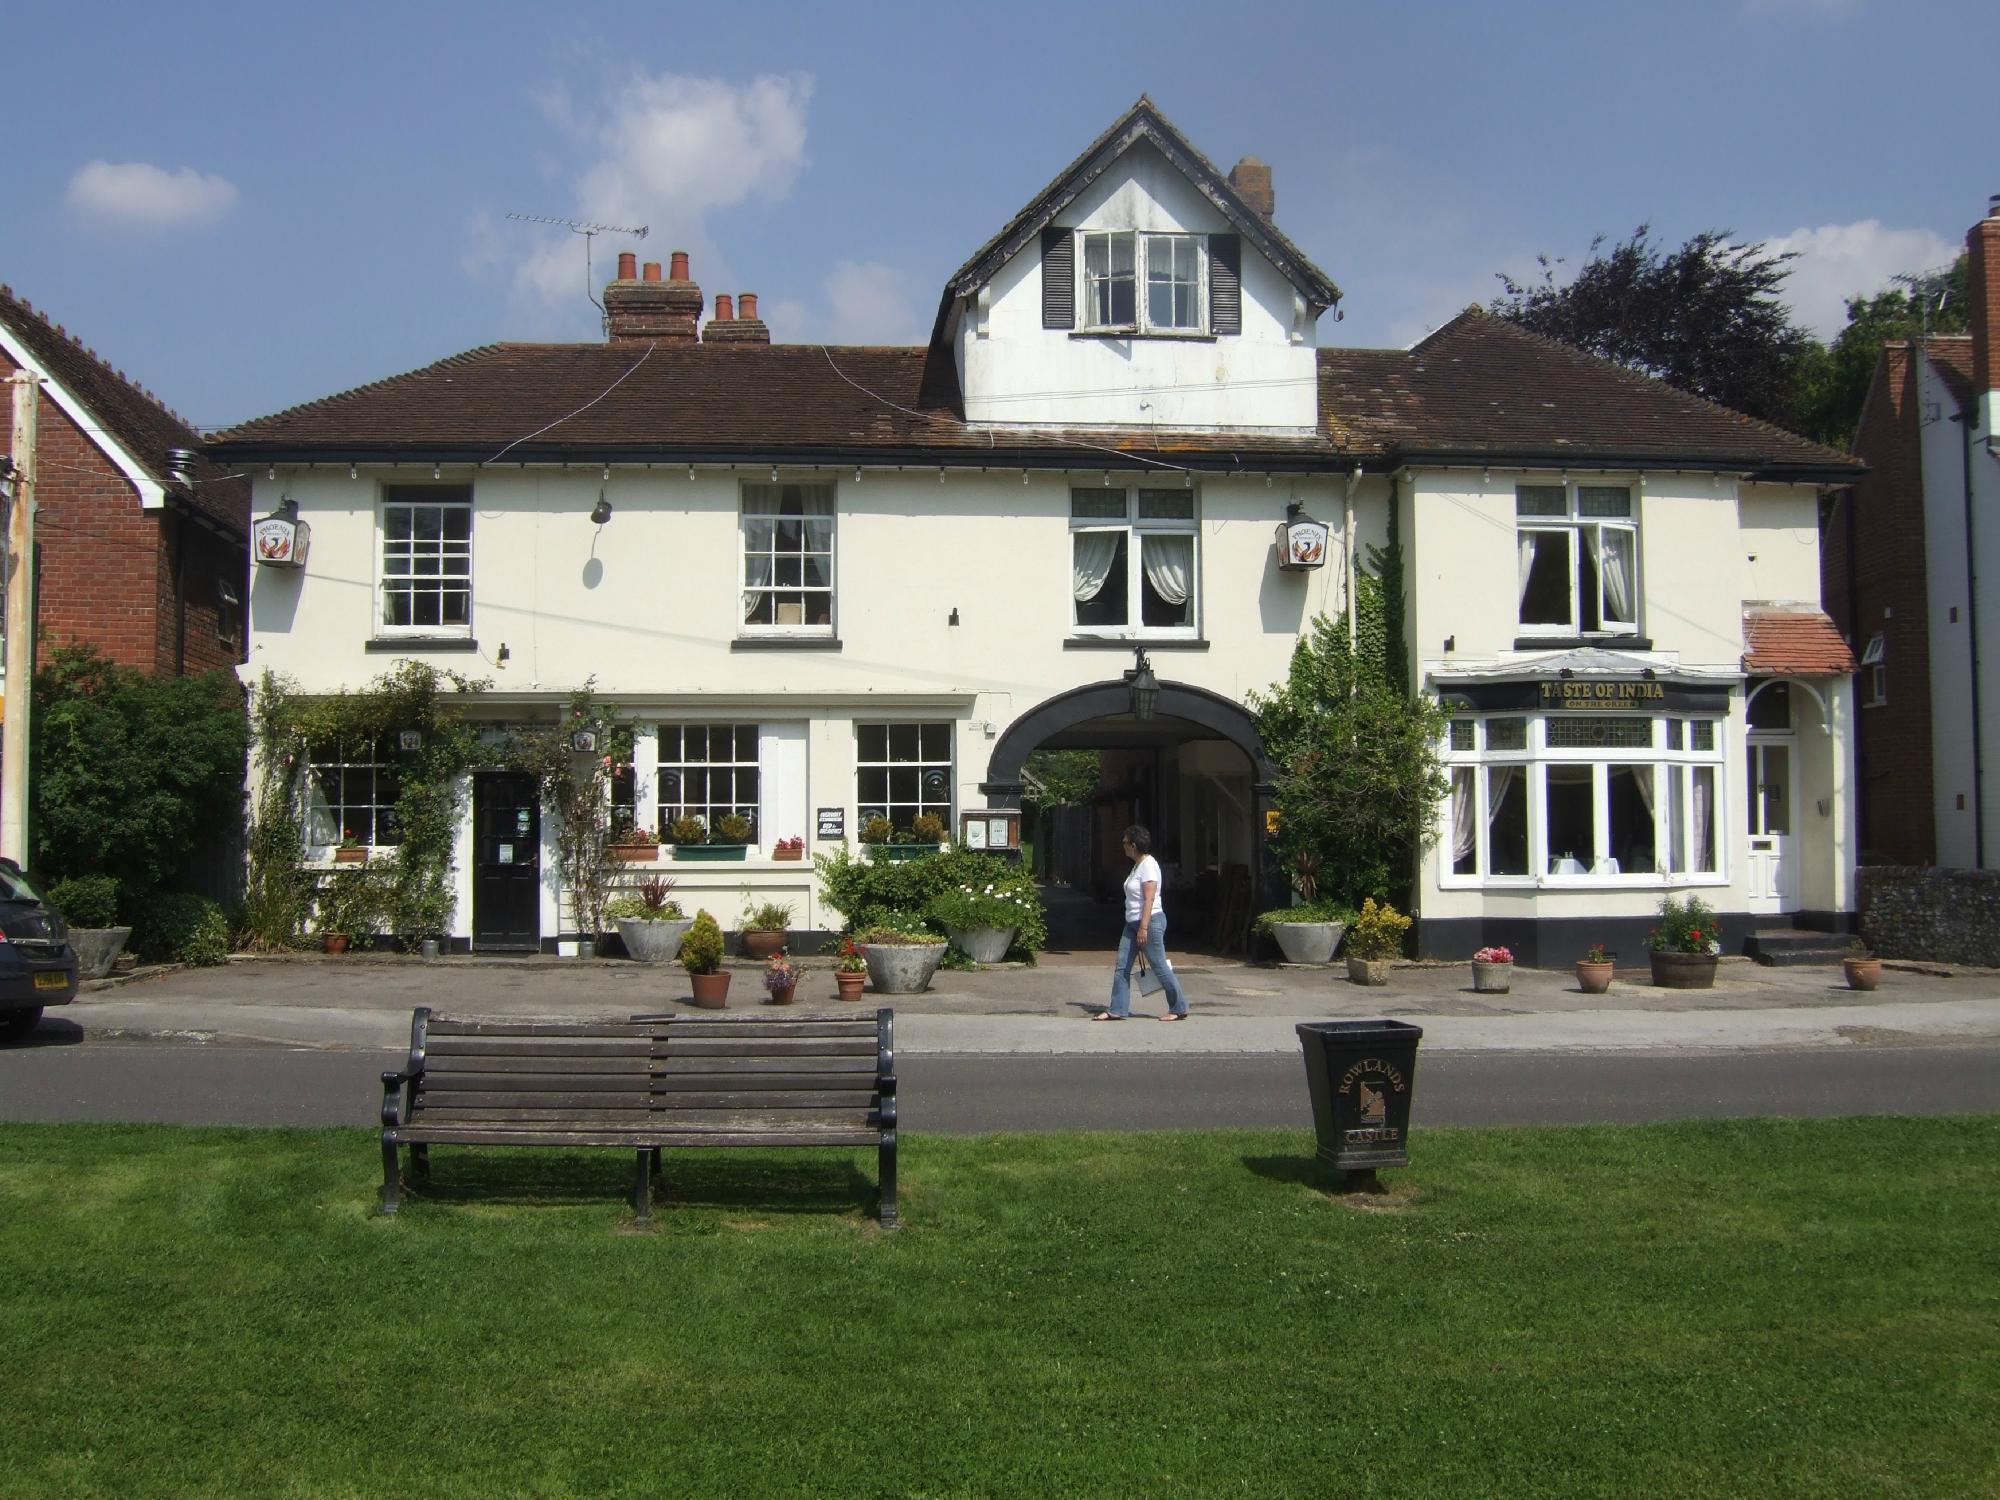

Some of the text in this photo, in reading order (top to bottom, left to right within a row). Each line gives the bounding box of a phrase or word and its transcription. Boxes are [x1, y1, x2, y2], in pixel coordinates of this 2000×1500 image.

[1541, 682, 1664, 698] TASTE OF INDIA
[1568, 700, 1635, 708] ON THE GREEN
[1338, 1059, 1405, 1096] ROWLANDS
[1345, 1129, 1399, 1143] CASTLE
